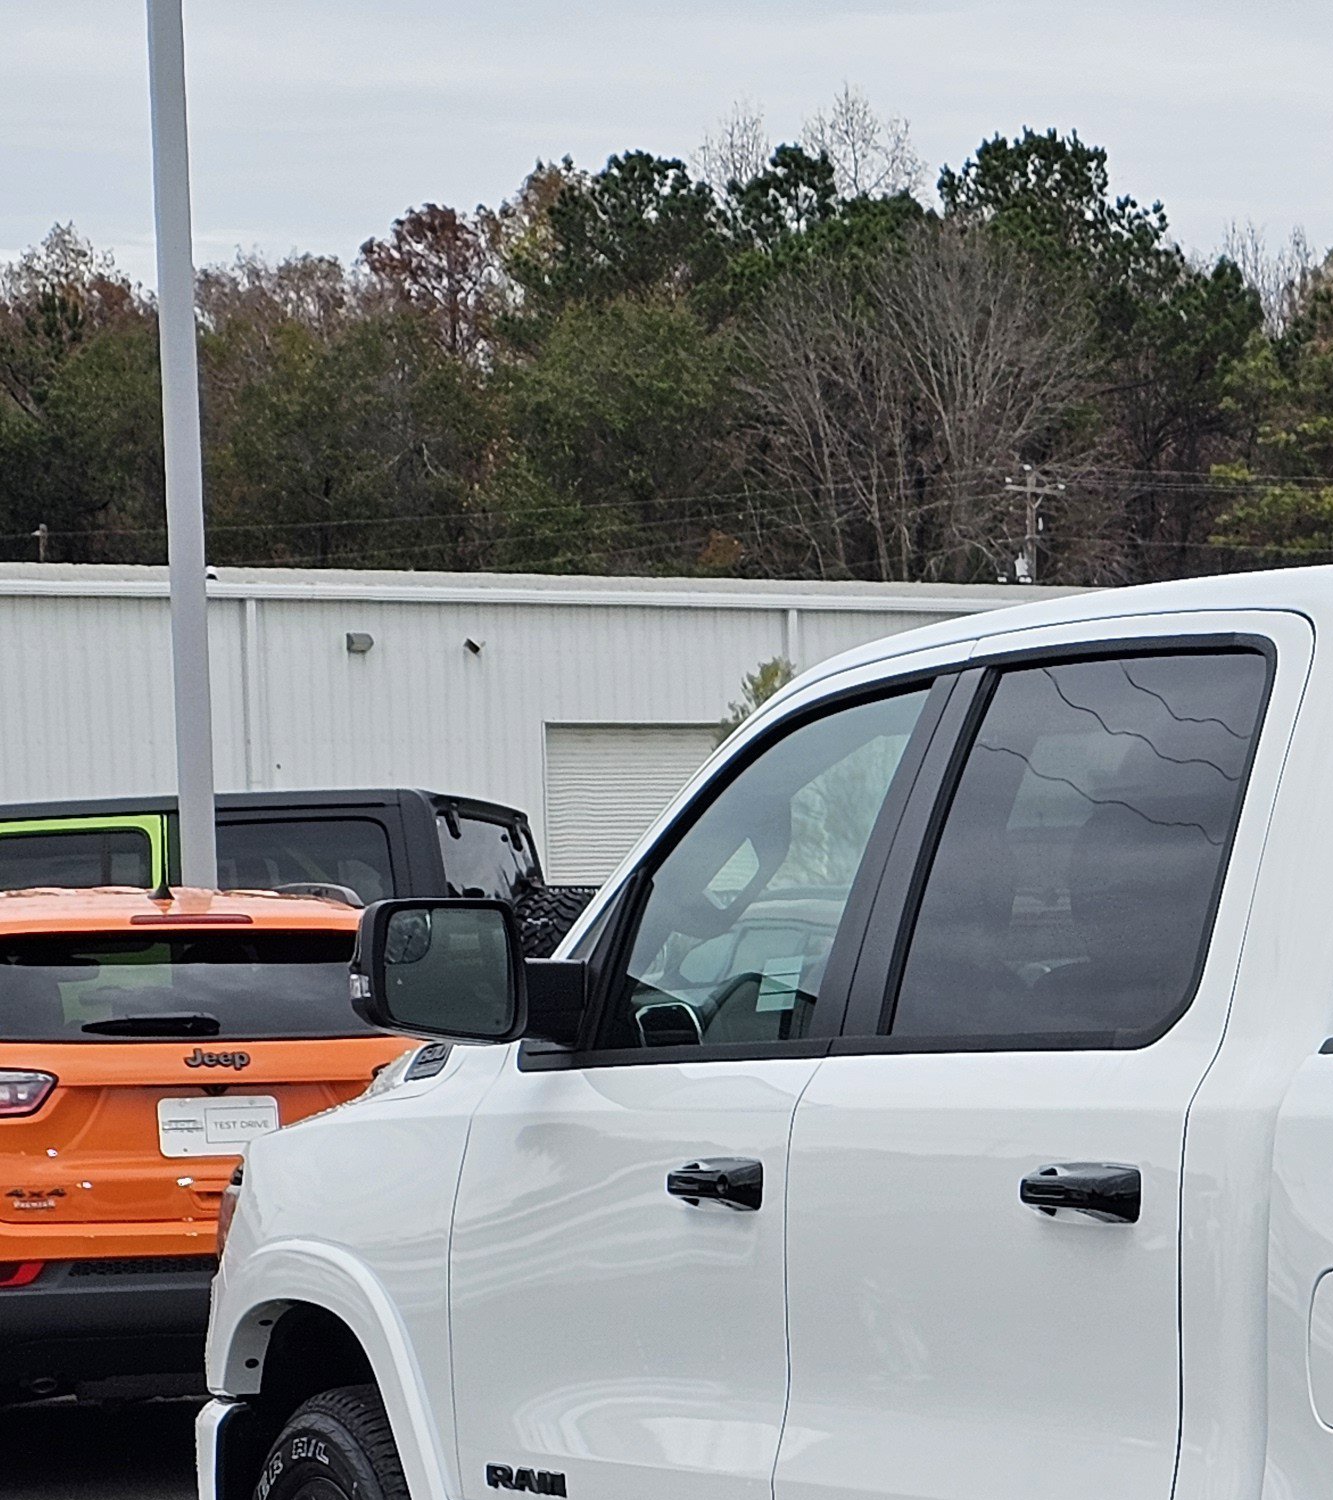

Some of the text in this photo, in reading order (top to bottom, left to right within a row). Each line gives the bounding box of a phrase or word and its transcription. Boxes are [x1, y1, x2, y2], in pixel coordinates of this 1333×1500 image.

[184, 1048, 251, 1071] Jeep
[213, 1121, 237, 1130] TEST
[240, 1120, 269, 1129] DRIVE
[486, 1463, 567, 1498] RAM
